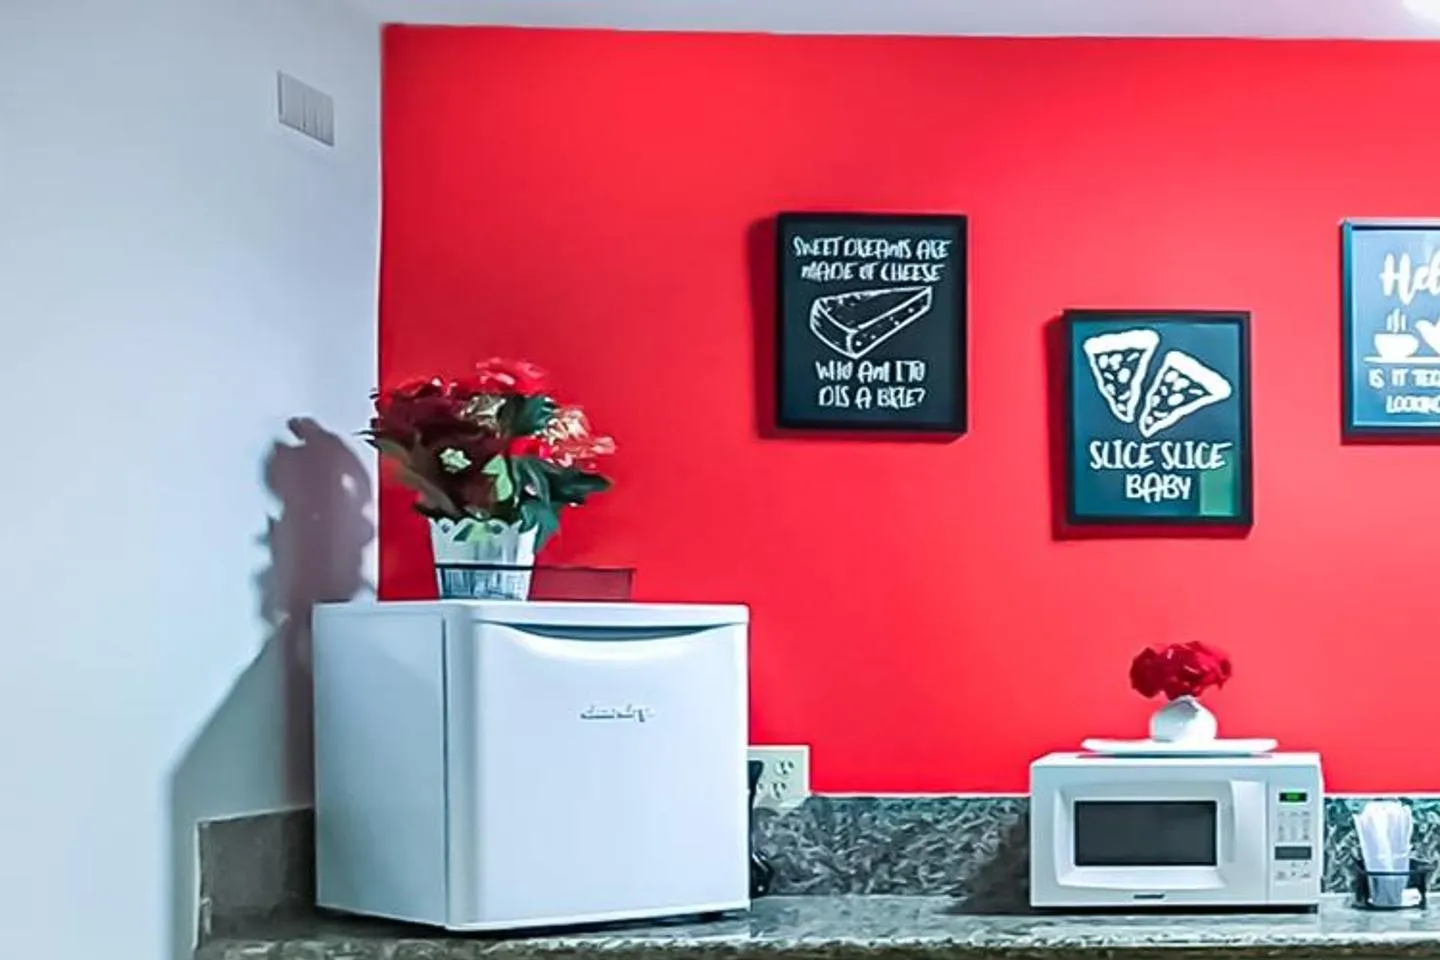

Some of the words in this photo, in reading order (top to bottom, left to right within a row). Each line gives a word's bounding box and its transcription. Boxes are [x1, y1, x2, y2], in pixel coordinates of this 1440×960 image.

[793, 235, 844, 257] SWEET
[844, 236, 911, 259] DREAMS
[916, 239, 952, 259] ARE
[801, 261, 858, 282] MADE
[859, 261, 880, 281] OF
[880, 262, 945, 282] CHEESE
[816, 360, 853, 380] WHO
[858, 361, 890, 382] AM
[895, 360, 903, 382] I
[903, 360, 926, 382] TO
[1368, 368, 1385, 388] IS
[1391, 368, 1409, 386] IT
[818, 385, 849, 407] DIS
[855, 386, 872, 409] A
[1089, 439, 1160, 469] SLICE
[1161, 440, 1232, 469] SLICE
[1126, 472, 1191, 503] BABY
